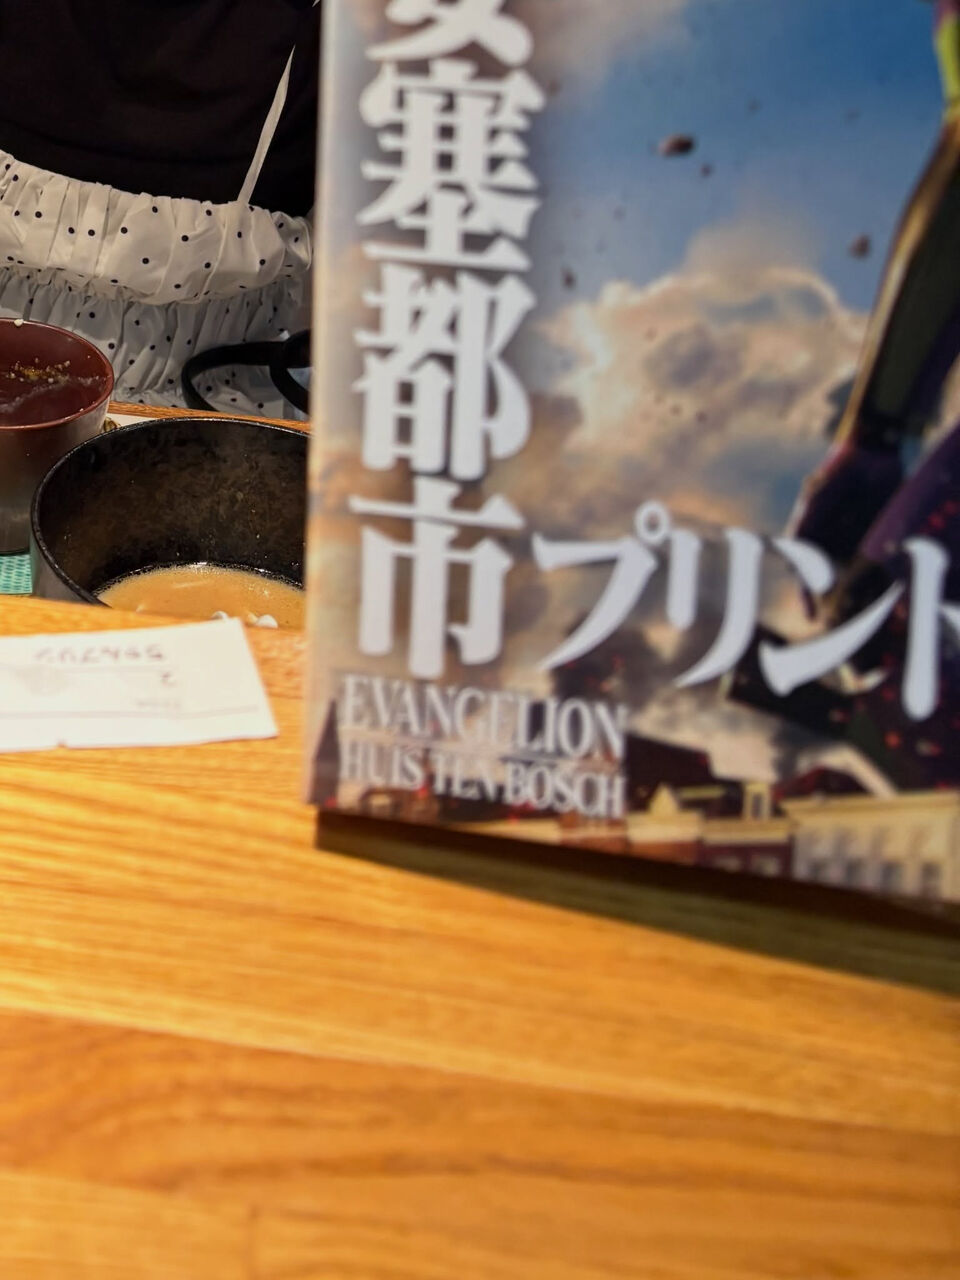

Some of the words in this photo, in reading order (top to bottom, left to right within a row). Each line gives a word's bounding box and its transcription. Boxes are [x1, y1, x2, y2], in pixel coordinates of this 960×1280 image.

[340, 673, 628, 757] EVANGELION
[339, 740, 425, 789] HUIS
[504, 762, 628, 820] BOSCH
